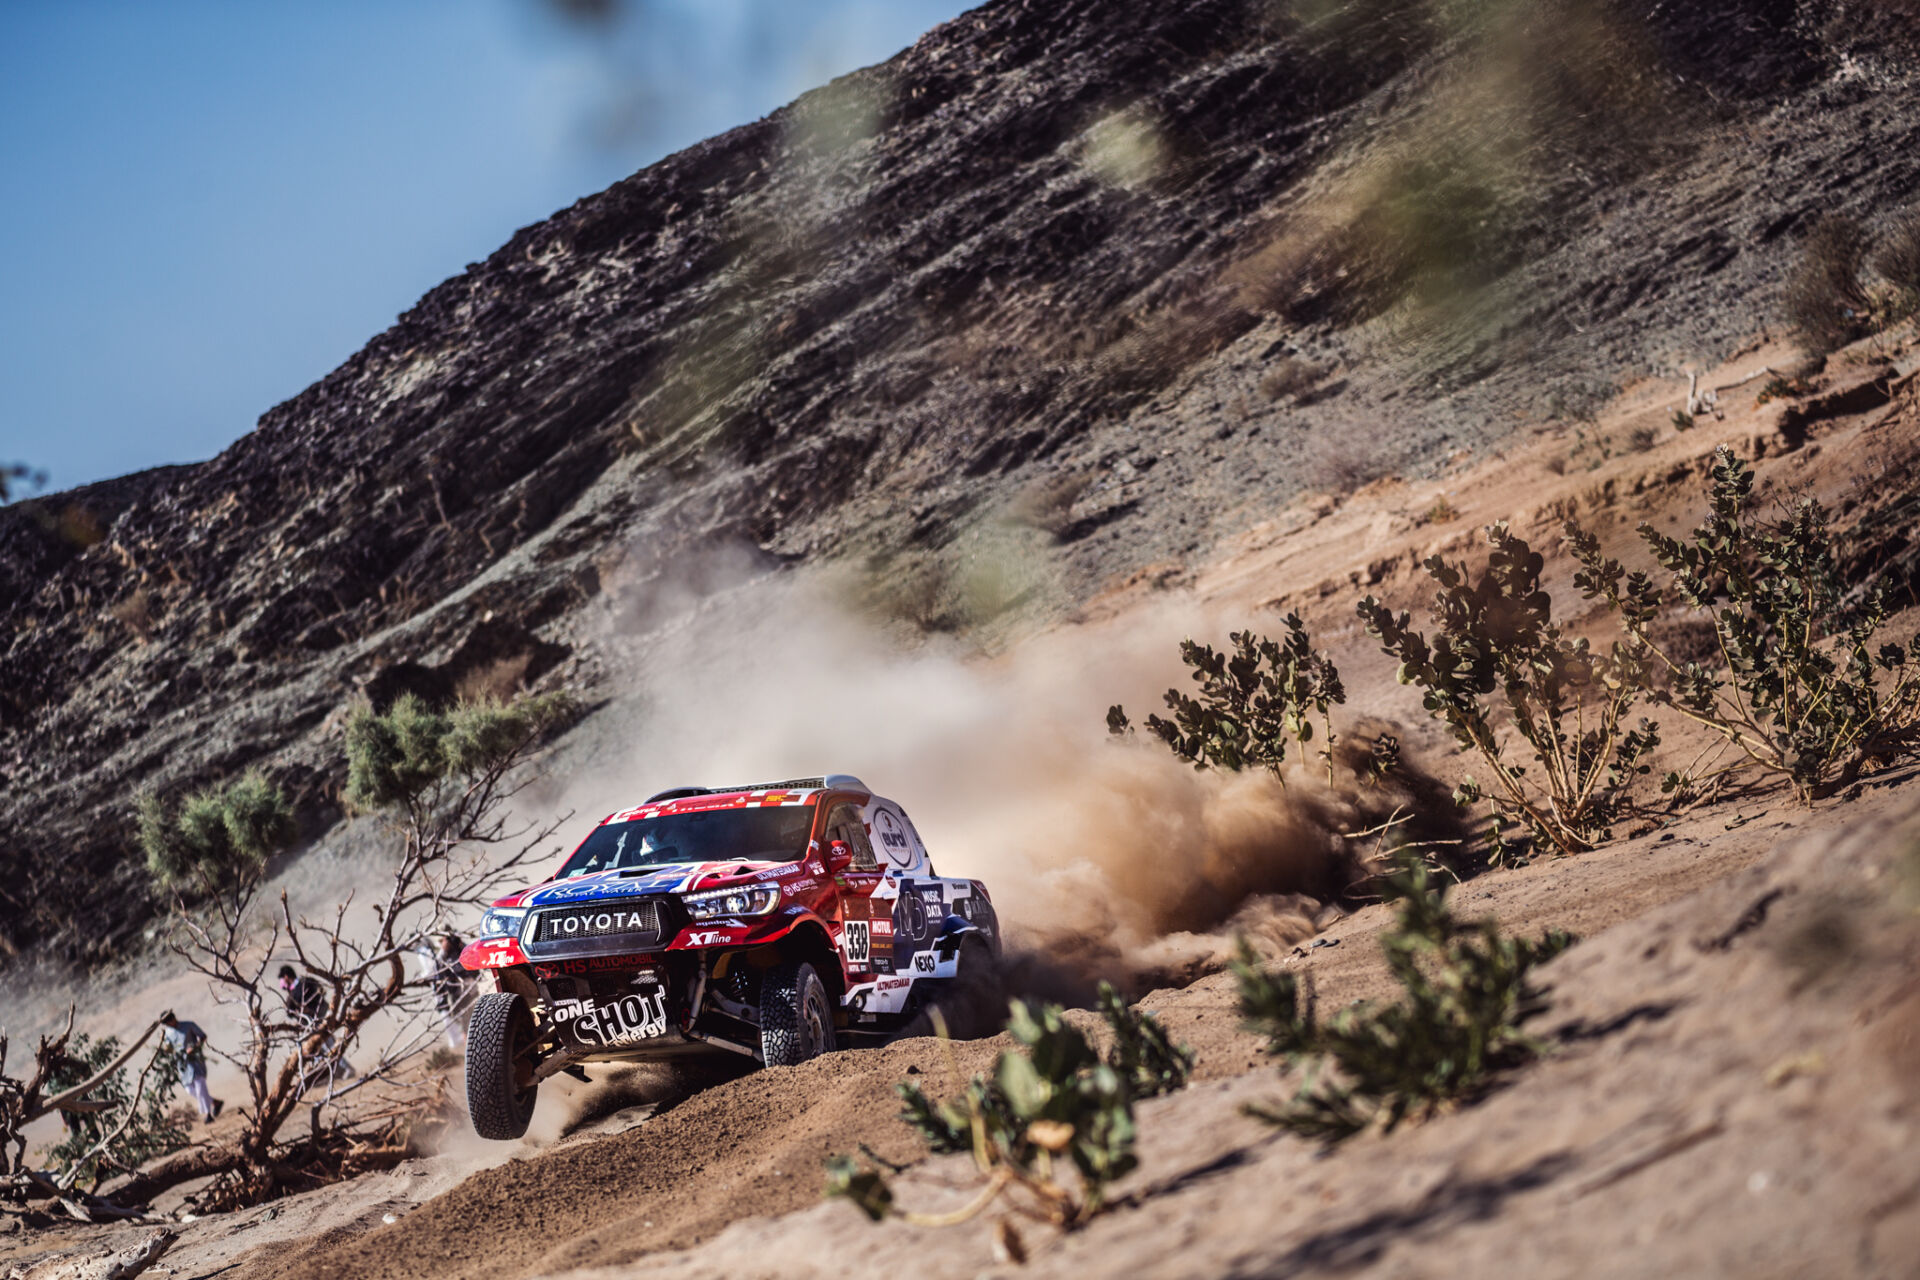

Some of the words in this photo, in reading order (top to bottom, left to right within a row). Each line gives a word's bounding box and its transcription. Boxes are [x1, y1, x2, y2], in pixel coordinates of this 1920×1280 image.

[544, 877, 670, 899] ROYAL
[926, 905, 943, 918] DATA
[550, 912, 643, 935] TOYOTA
[872, 920, 892, 934] MOTUL
[685, 930, 732, 947] XTline
[846, 922, 869, 960] 338
[563, 960, 588, 975] HS
[914, 955, 936, 974] NEXO
[554, 998, 595, 1023] ONE
[573, 984, 667, 1047] SHOT
